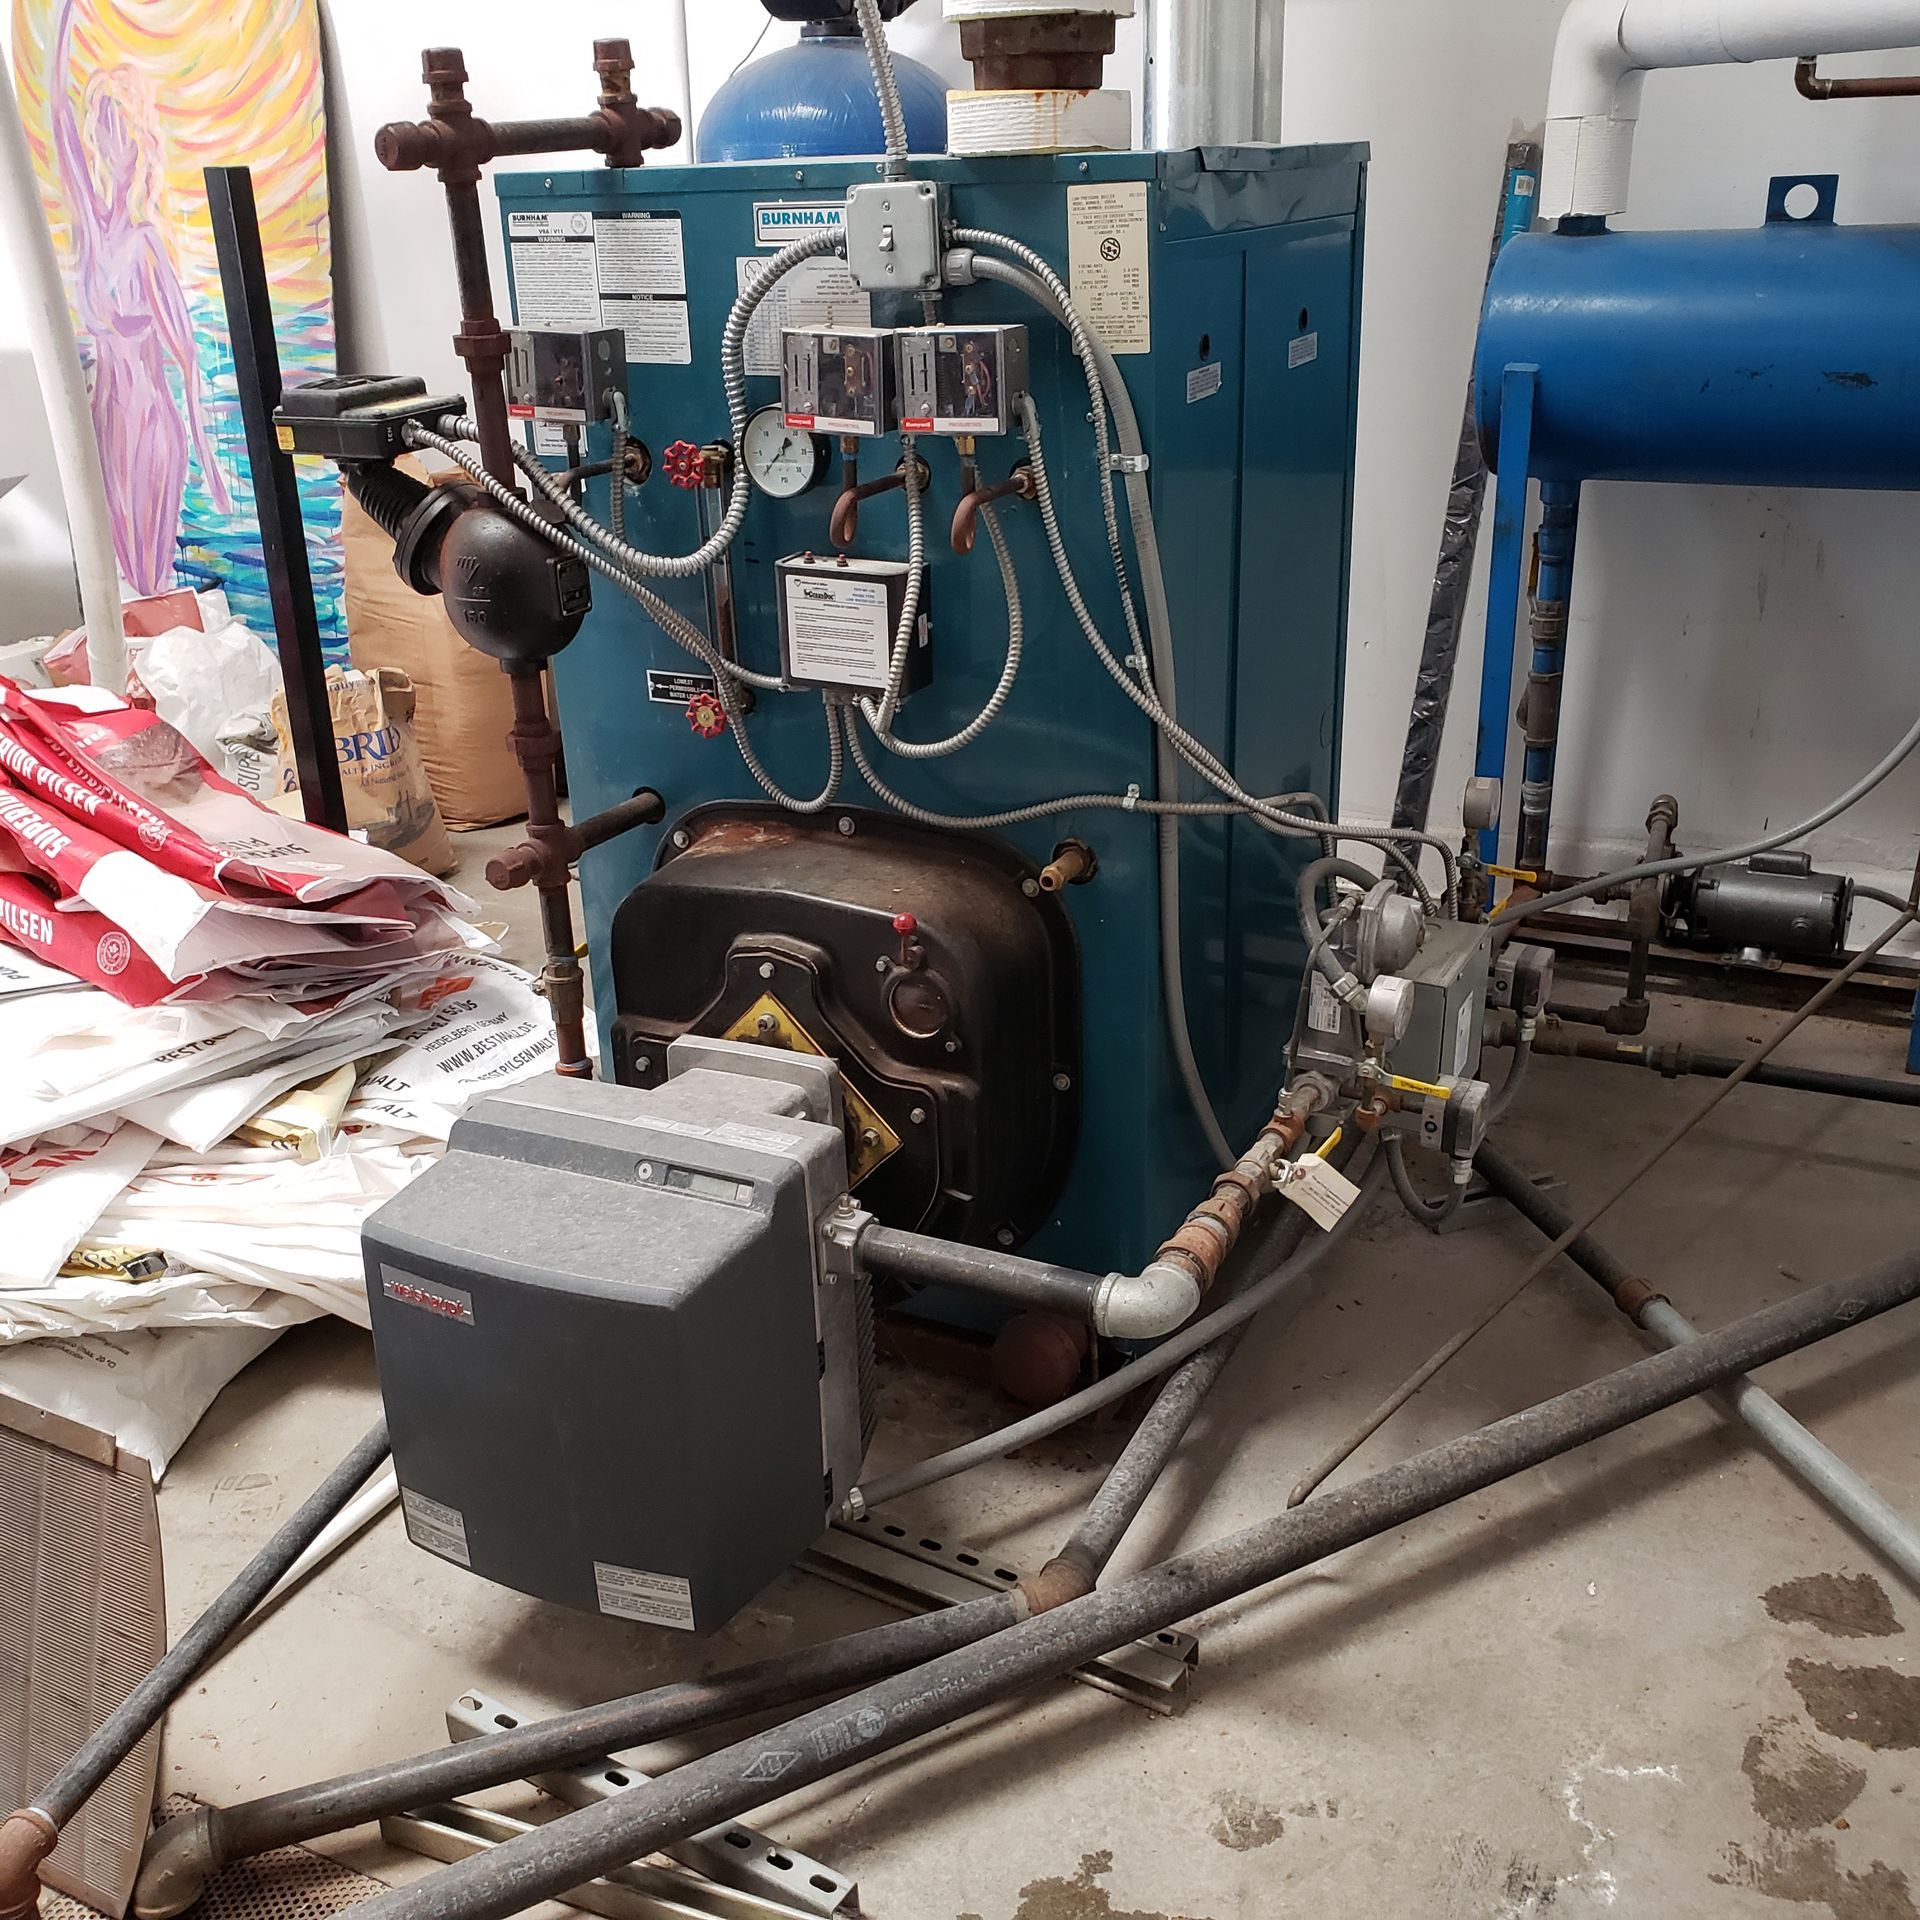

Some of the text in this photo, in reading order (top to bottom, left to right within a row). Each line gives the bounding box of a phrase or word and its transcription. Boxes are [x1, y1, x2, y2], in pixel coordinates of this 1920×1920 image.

[512, 214, 549, 222] BURNHAM
[761, 211, 841, 226] BURNHAM
[36, 766, 106, 817] PILSEN
[0, 898, 53, 945] ILSEN
[422, 1024, 477, 1054] HEIDELBERG
[154, 1041, 204, 1064] BEST
[499, 1045, 536, 1075] PILSEN
[529, 1037, 556, 1057] MALT
[370, 1104, 418, 1119] ALT
